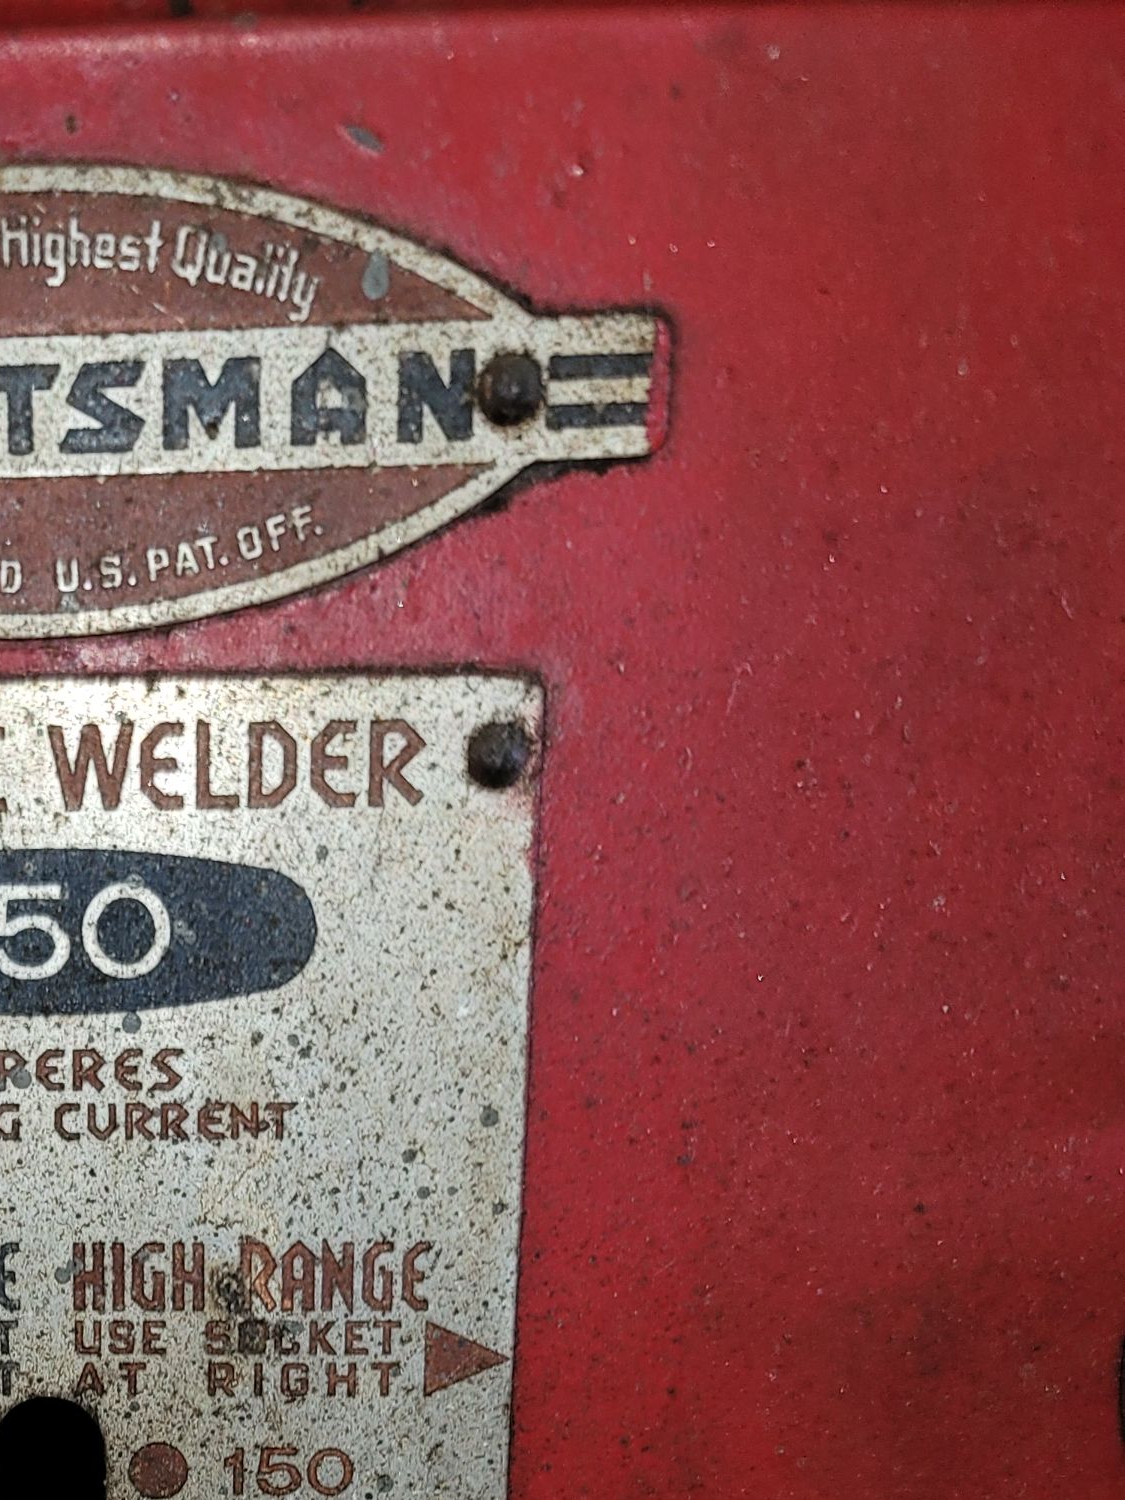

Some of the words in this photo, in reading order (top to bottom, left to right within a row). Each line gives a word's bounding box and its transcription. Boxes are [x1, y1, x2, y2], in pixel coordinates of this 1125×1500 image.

[0, 218, 165, 288] Highest
[172, 225, 322, 322] Quality
[47, 718, 427, 812] WELDER
[54, 1100, 296, 1142] CURRENT
[73, 1241, 205, 1313] HIGH
[241, 1236, 434, 1313] RANGE
[75, 1319, 167, 1357] USE
[204, 1319, 402, 1357] SOCKET
[75, 1361, 148, 1397] AT
[206, 1361, 401, 1398] RIGHT
[223, 1445, 355, 1498] 150
